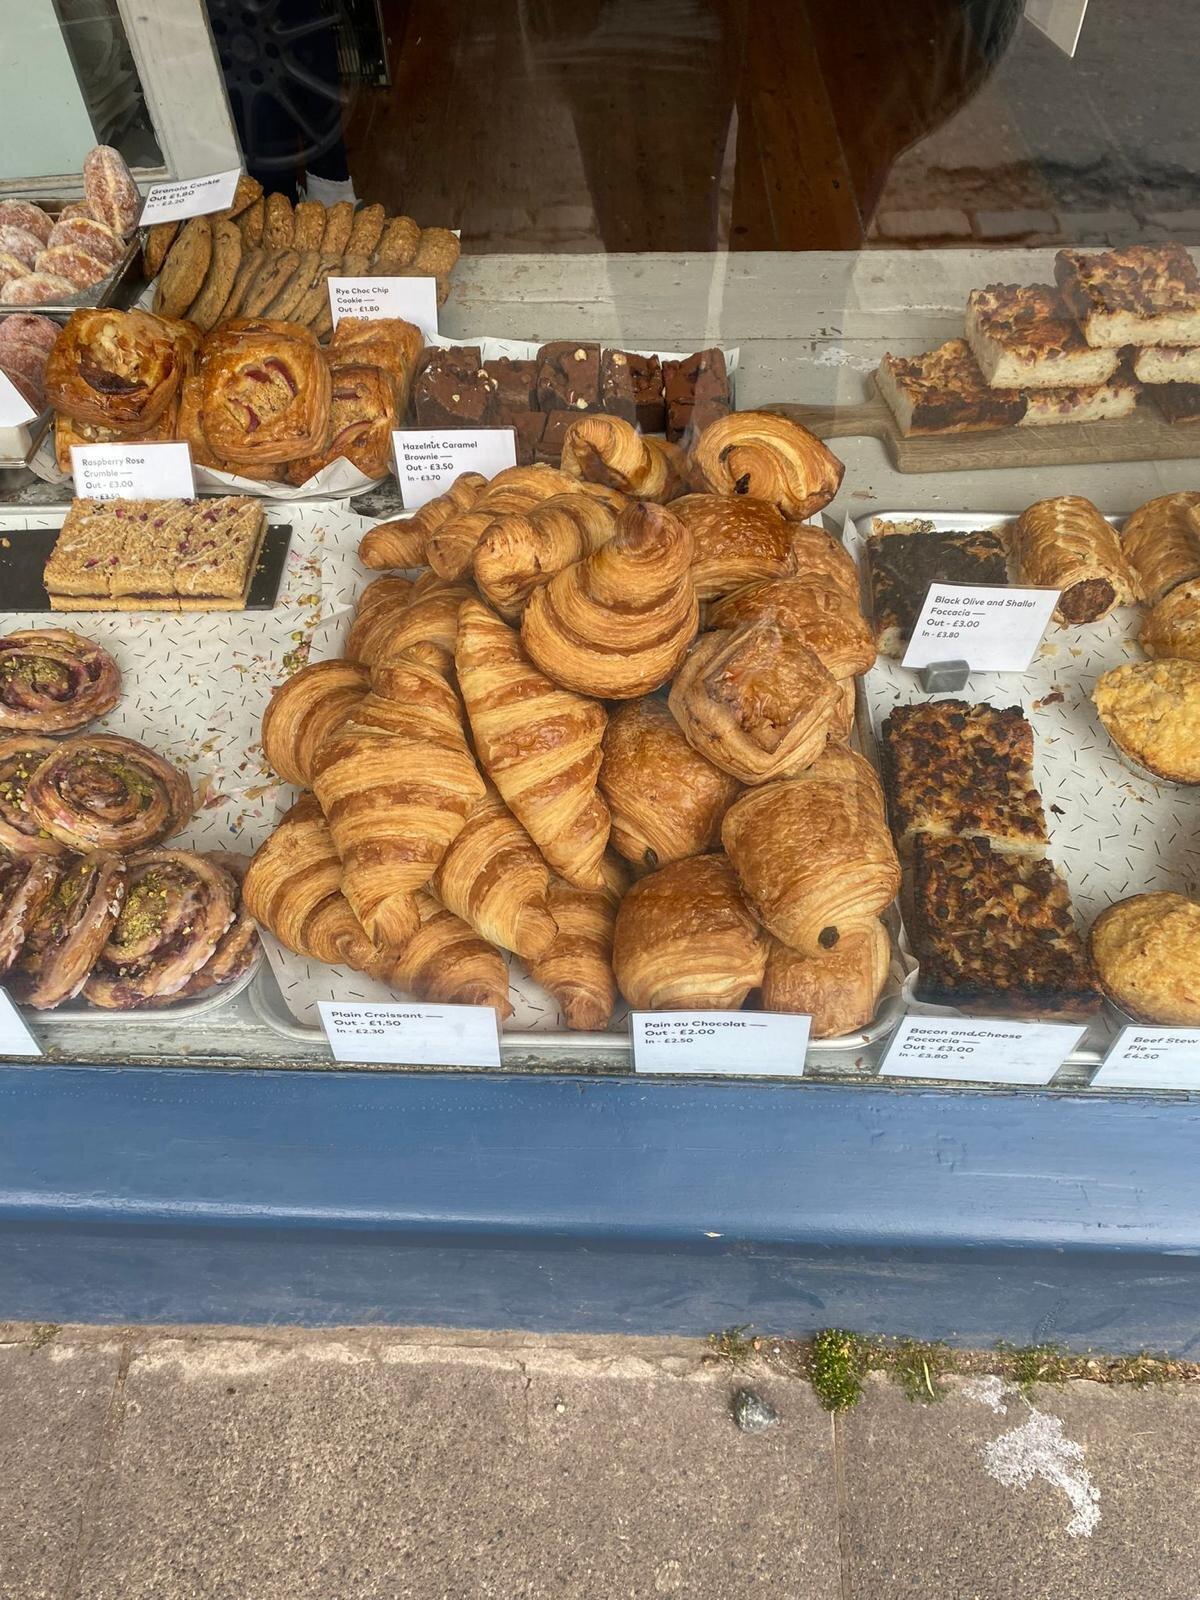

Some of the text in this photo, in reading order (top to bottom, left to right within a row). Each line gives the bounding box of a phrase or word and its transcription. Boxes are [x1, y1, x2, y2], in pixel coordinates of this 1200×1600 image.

[152, 178, 220, 194] Granola Cookie
[403, 441, 440, 450] Hazelnut
[82, 458, 124, 467] Raspberry
[84, 469, 118, 478] Crumble
[935, 595, 960, 605] Black
[962, 597, 984, 606] Olive
[930, 608, 970, 616] Foccacia
[926, 618, 944, 627] Out
